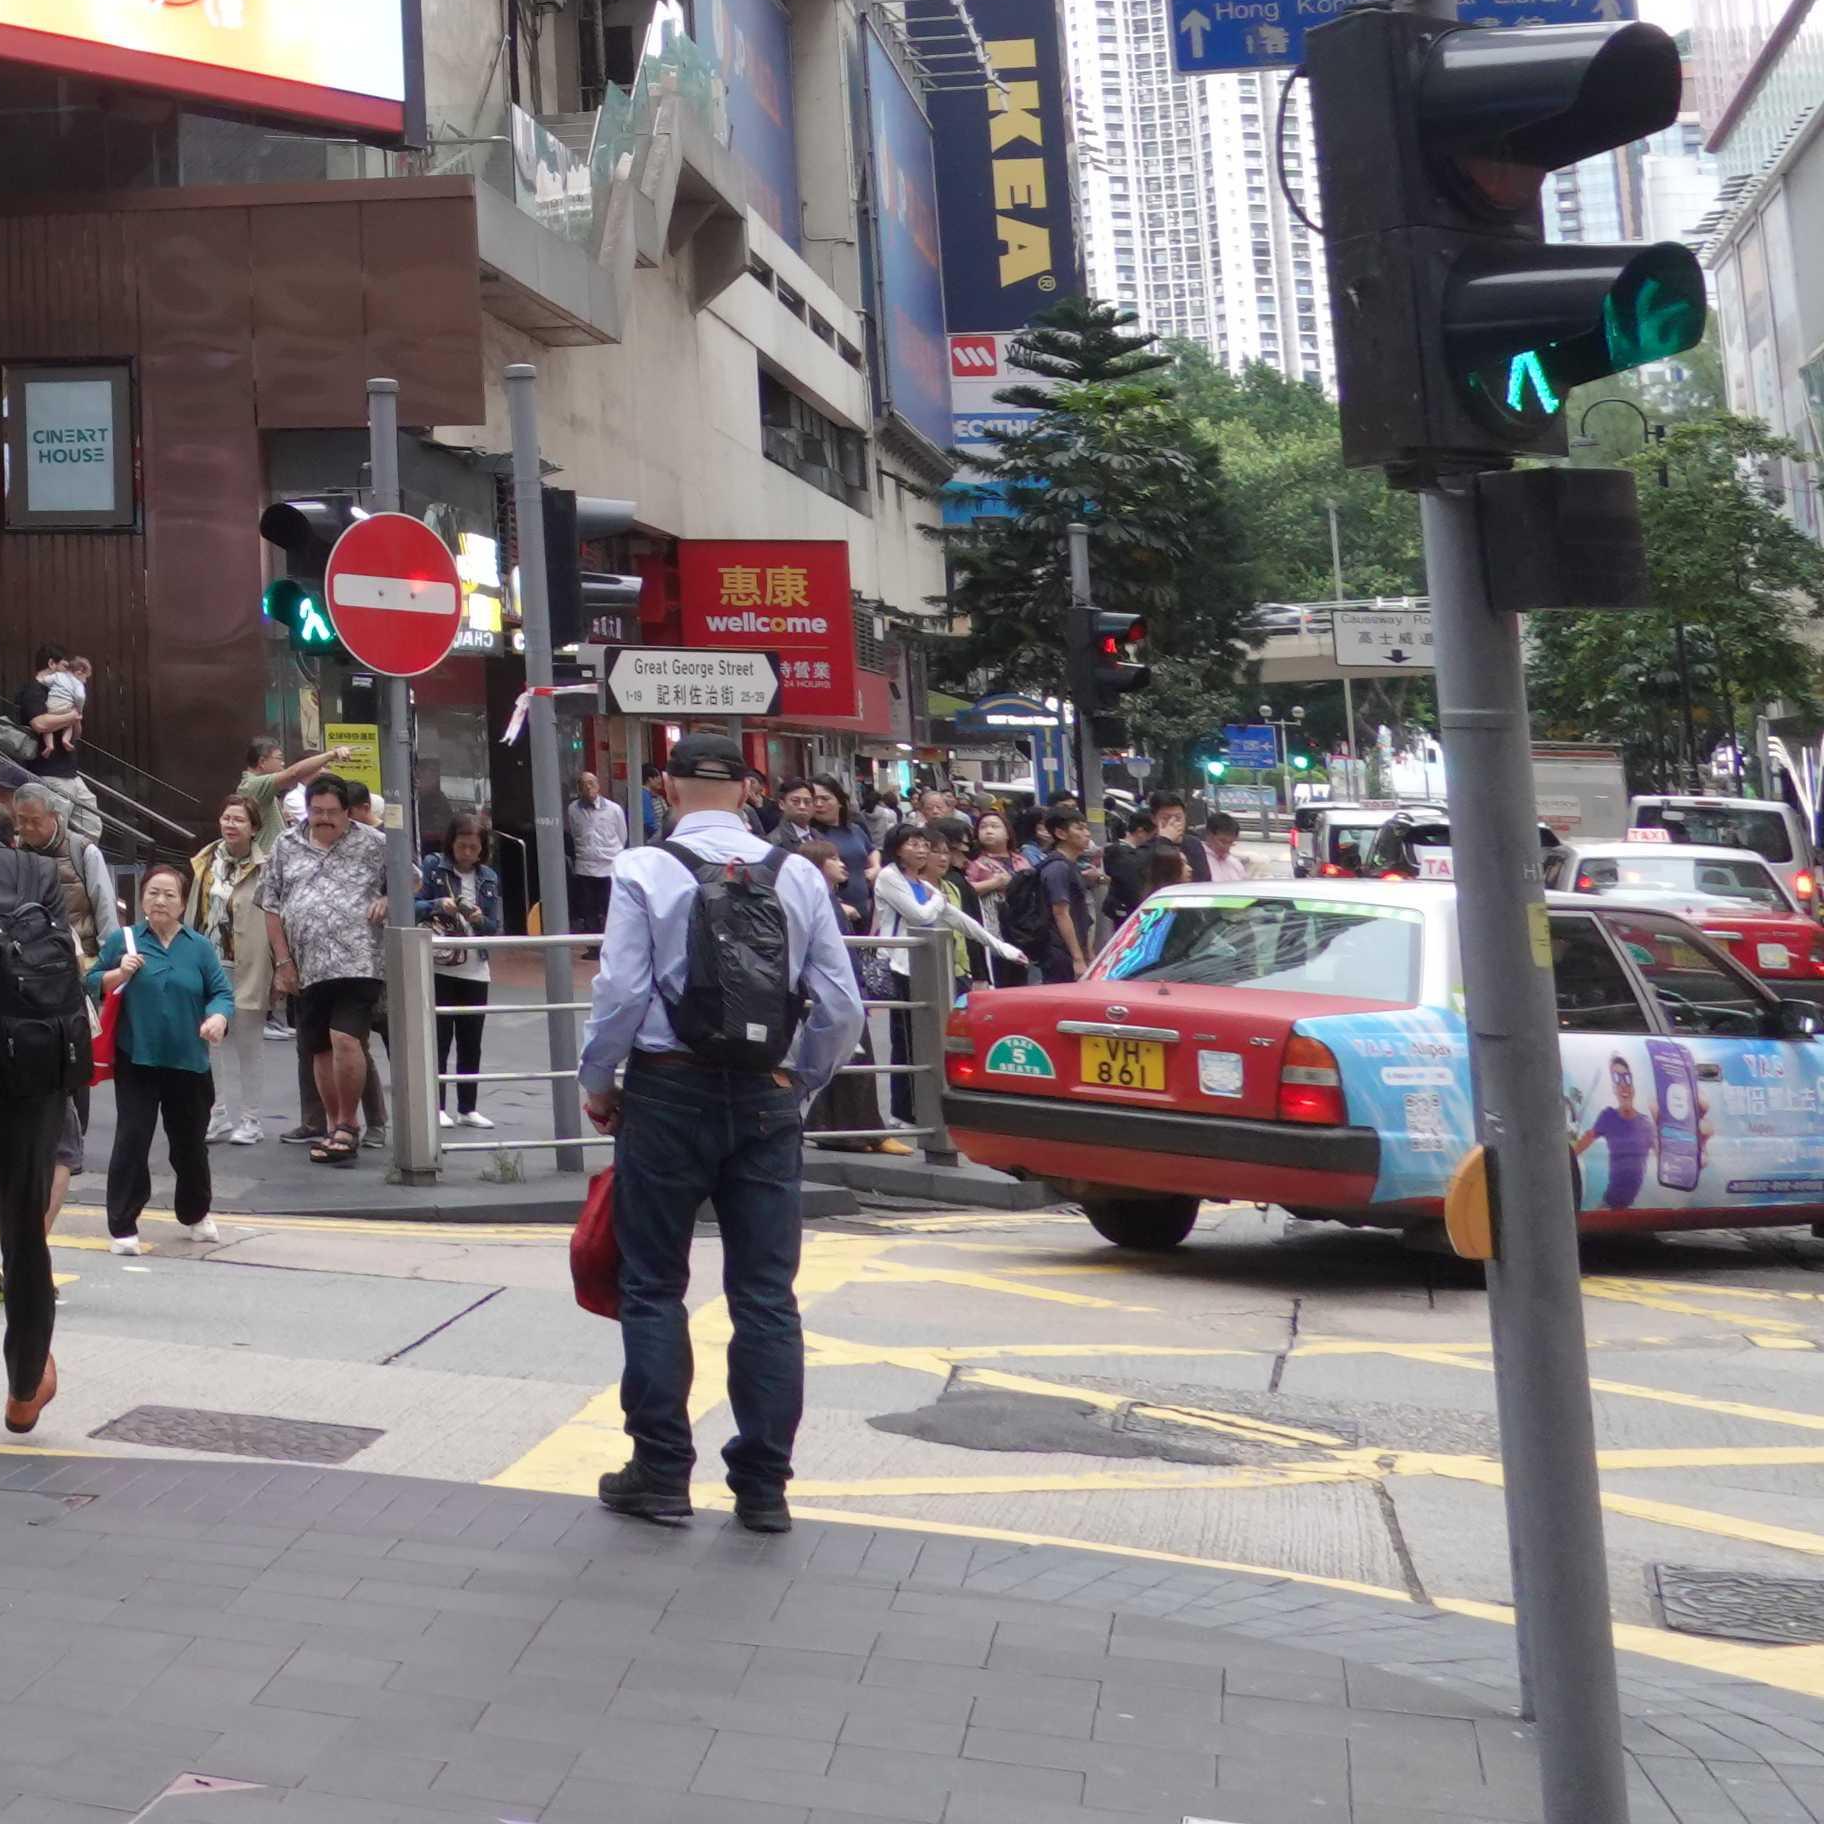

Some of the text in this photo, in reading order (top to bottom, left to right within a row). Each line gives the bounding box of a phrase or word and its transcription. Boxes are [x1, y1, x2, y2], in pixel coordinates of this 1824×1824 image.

[1216, 2, 1280, 23] Hong
[984, 38, 1052, 288] IKEA
[33, 427, 108, 444] CINEART
[38, 448, 104, 464] HOUSE
[718, 564, 810, 607] 惠康
[706, 612, 829, 634] wellcome
[1340, 615, 1432, 626] Causeway Ro
[634, 658, 754, 678] Great George Street
[657, 684, 734, 706] 記利佐治街
[1630, 829, 1668, 841] TAXI
[1425, 860, 1453, 875] TA
[1004, 1039, 1034, 1051] TAXI
[1107, 1040, 1140, 1064] VH
[1012, 1050, 1026, 1064] 5
[1097, 1062, 1146, 1087] 861
